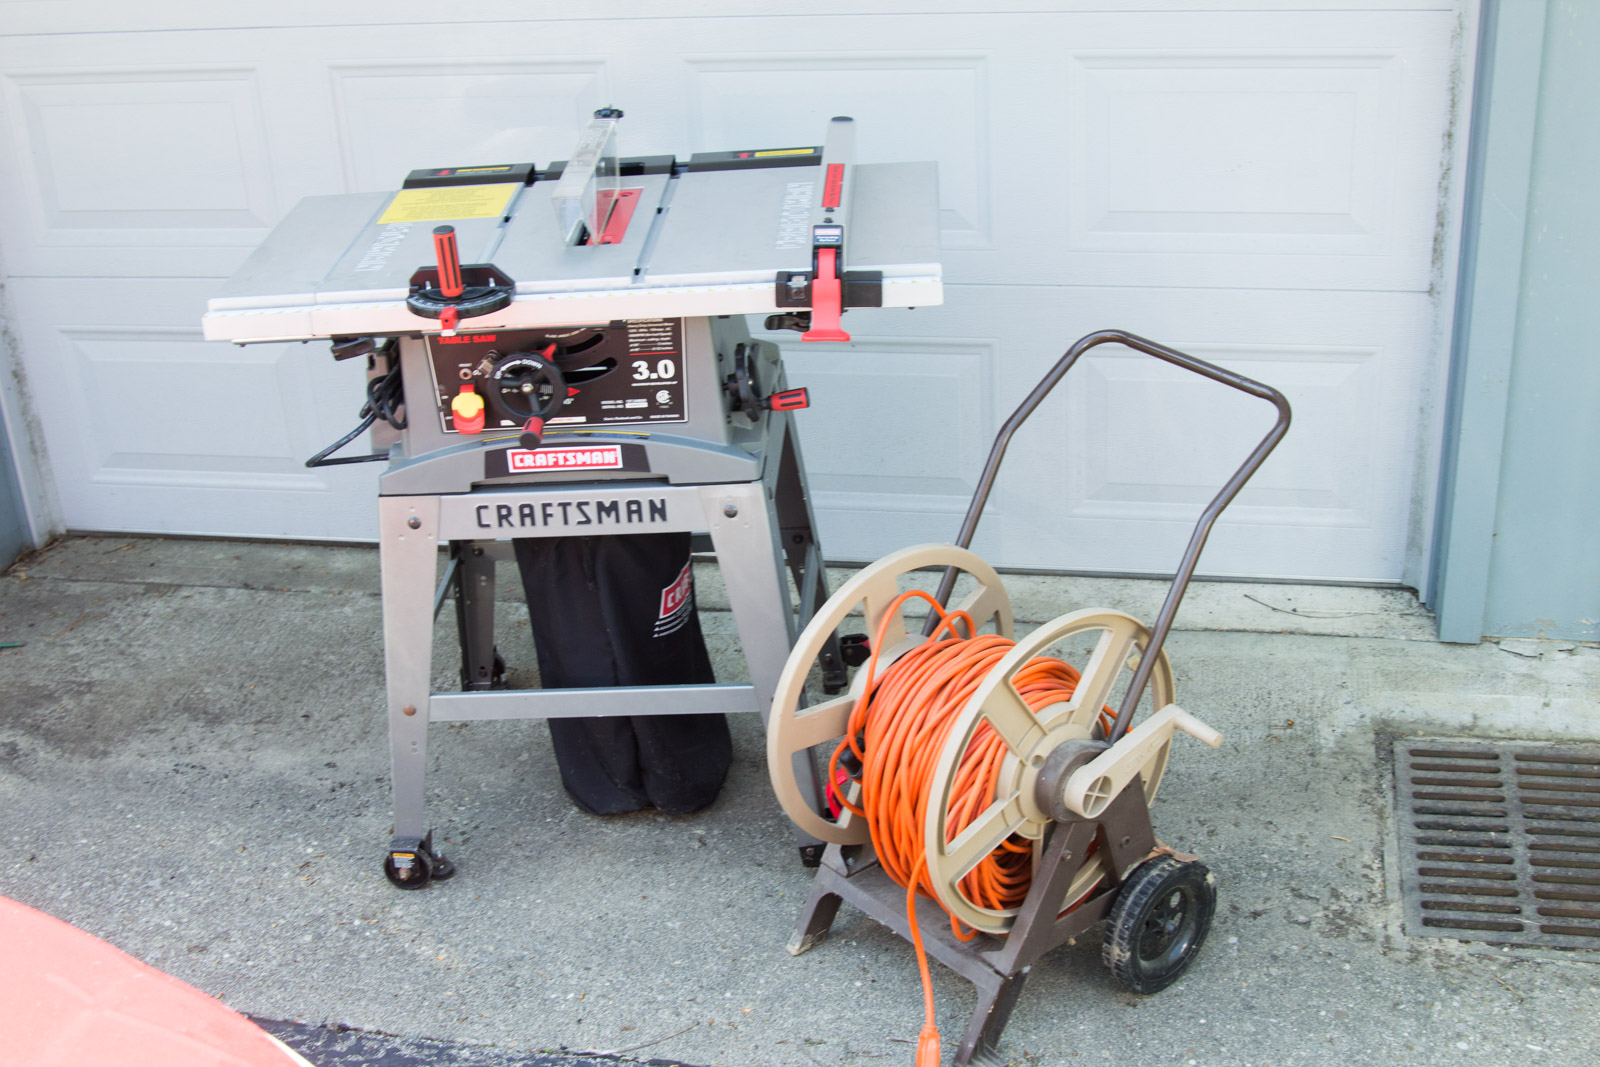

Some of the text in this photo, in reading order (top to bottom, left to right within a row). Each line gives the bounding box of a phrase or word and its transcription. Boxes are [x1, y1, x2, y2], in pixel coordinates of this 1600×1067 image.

[436, 334, 497, 345] TABLE SAW
[520, 358, 544, 369] DOWN
[631, 359, 676, 380] 3.0
[514, 450, 617, 468] CRAFTSMAN
[475, 498, 667, 528] CRAFTSMAN
